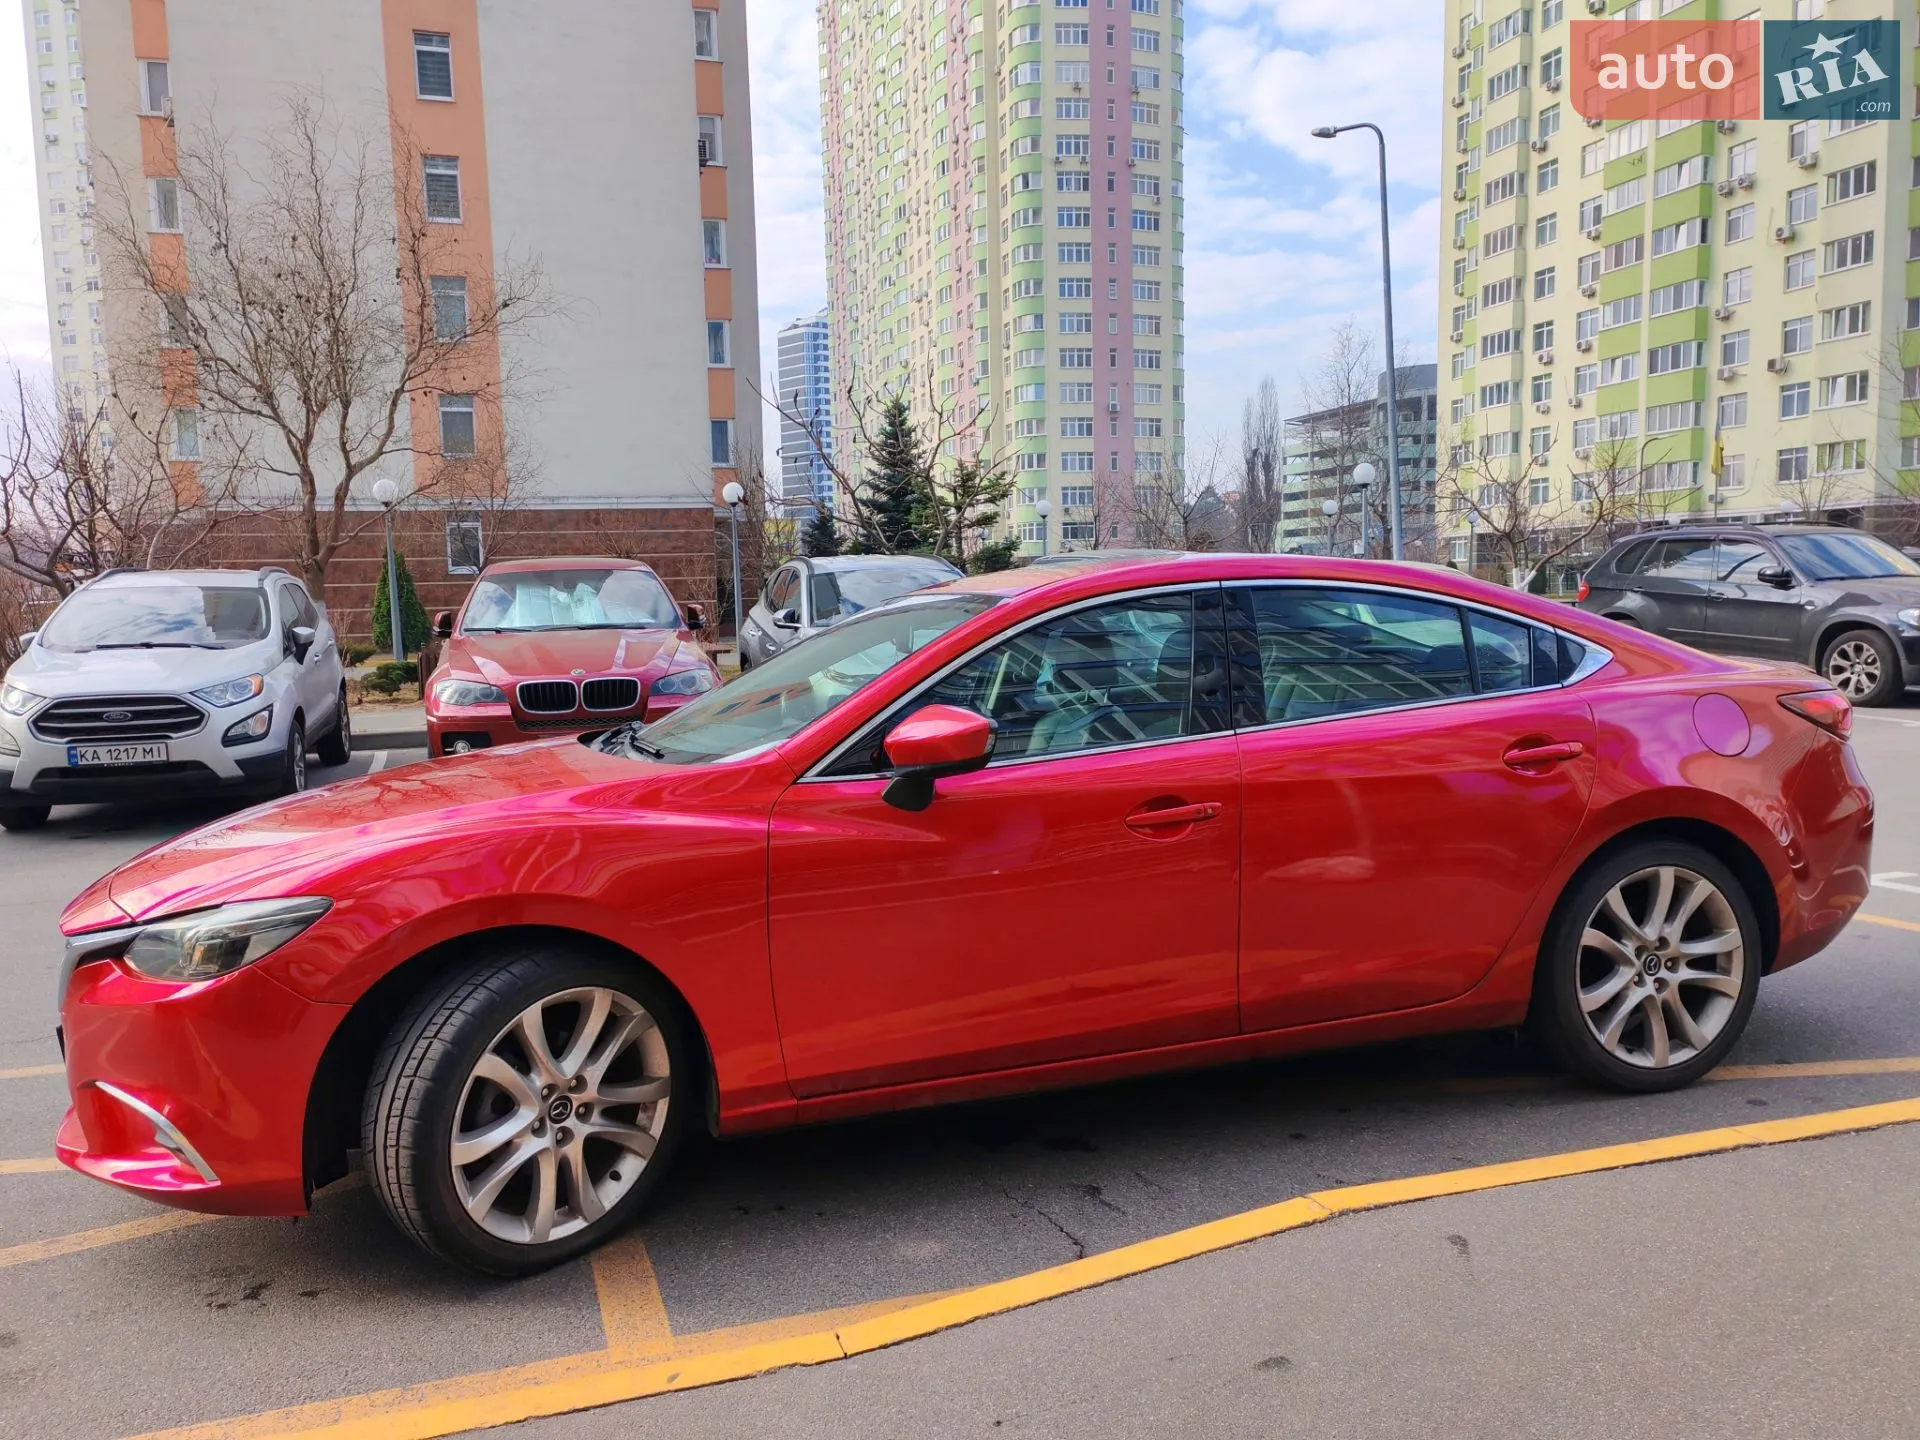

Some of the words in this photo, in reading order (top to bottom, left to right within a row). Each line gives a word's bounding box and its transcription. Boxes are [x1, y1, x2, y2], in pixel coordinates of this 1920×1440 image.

[79, 749, 101, 762] KA
[106, 747, 138, 761] 1217
[142, 746, 161, 759] MI
